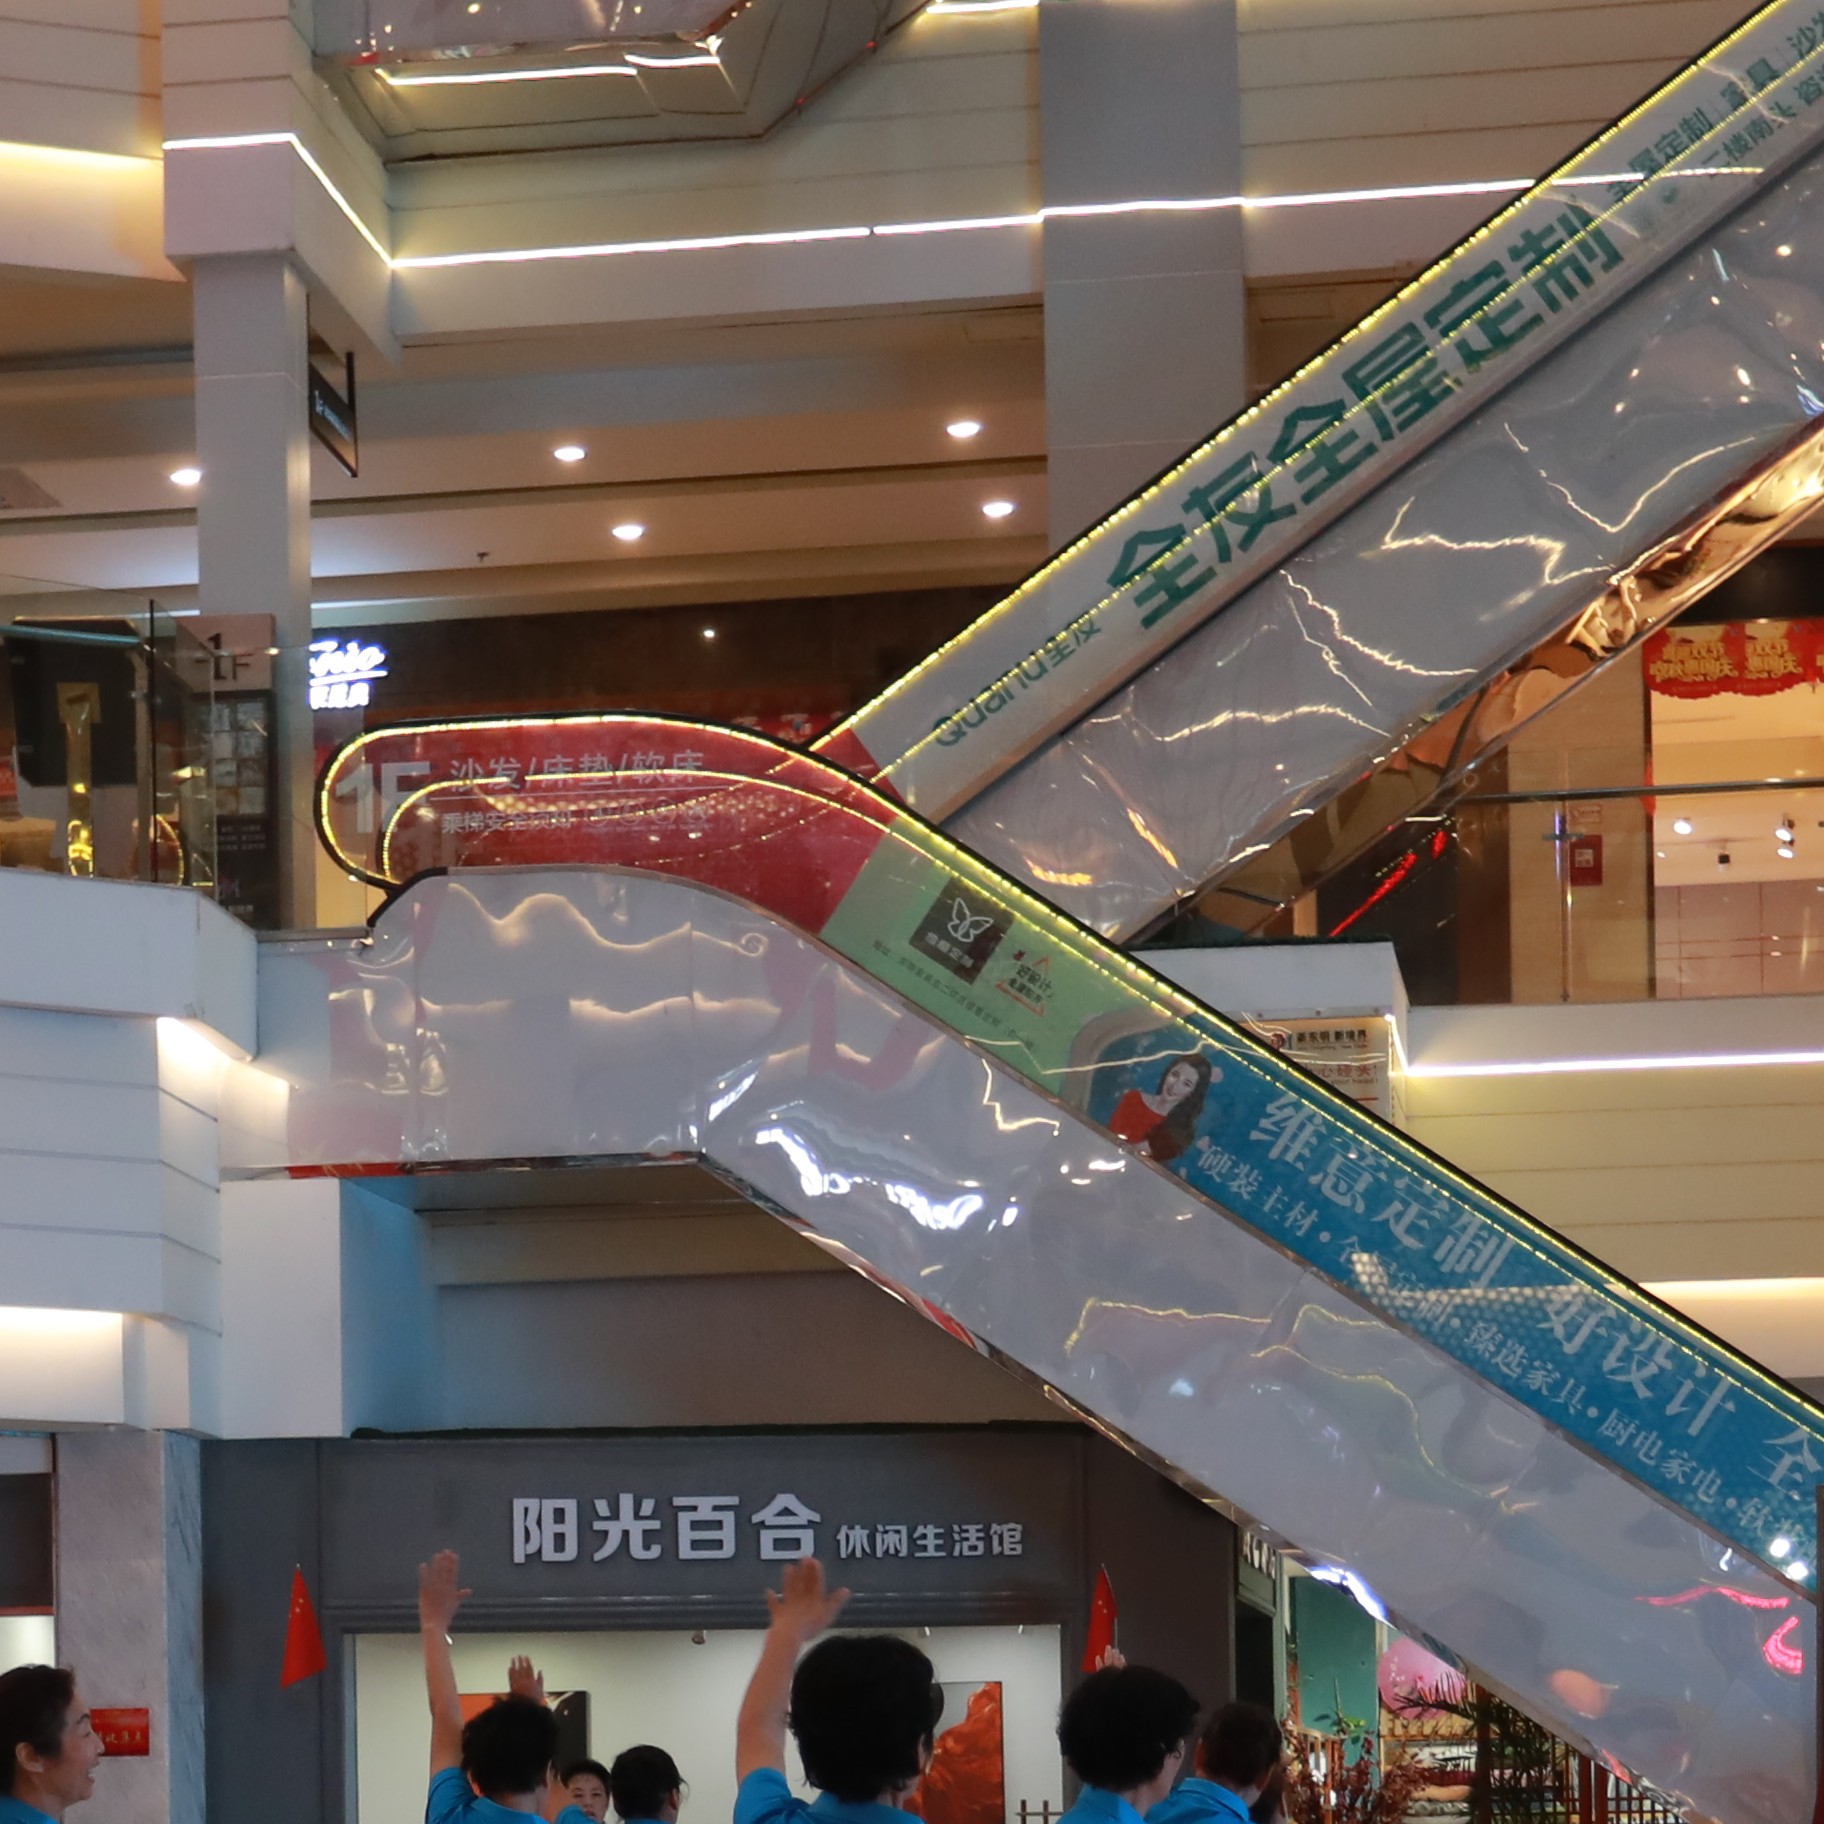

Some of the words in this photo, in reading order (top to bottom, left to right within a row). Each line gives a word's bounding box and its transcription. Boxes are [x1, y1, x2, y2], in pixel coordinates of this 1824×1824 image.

[512, 1492, 822, 1565] 阳光百合
[836, 1520, 1025, 1560] 休闲生活馆
